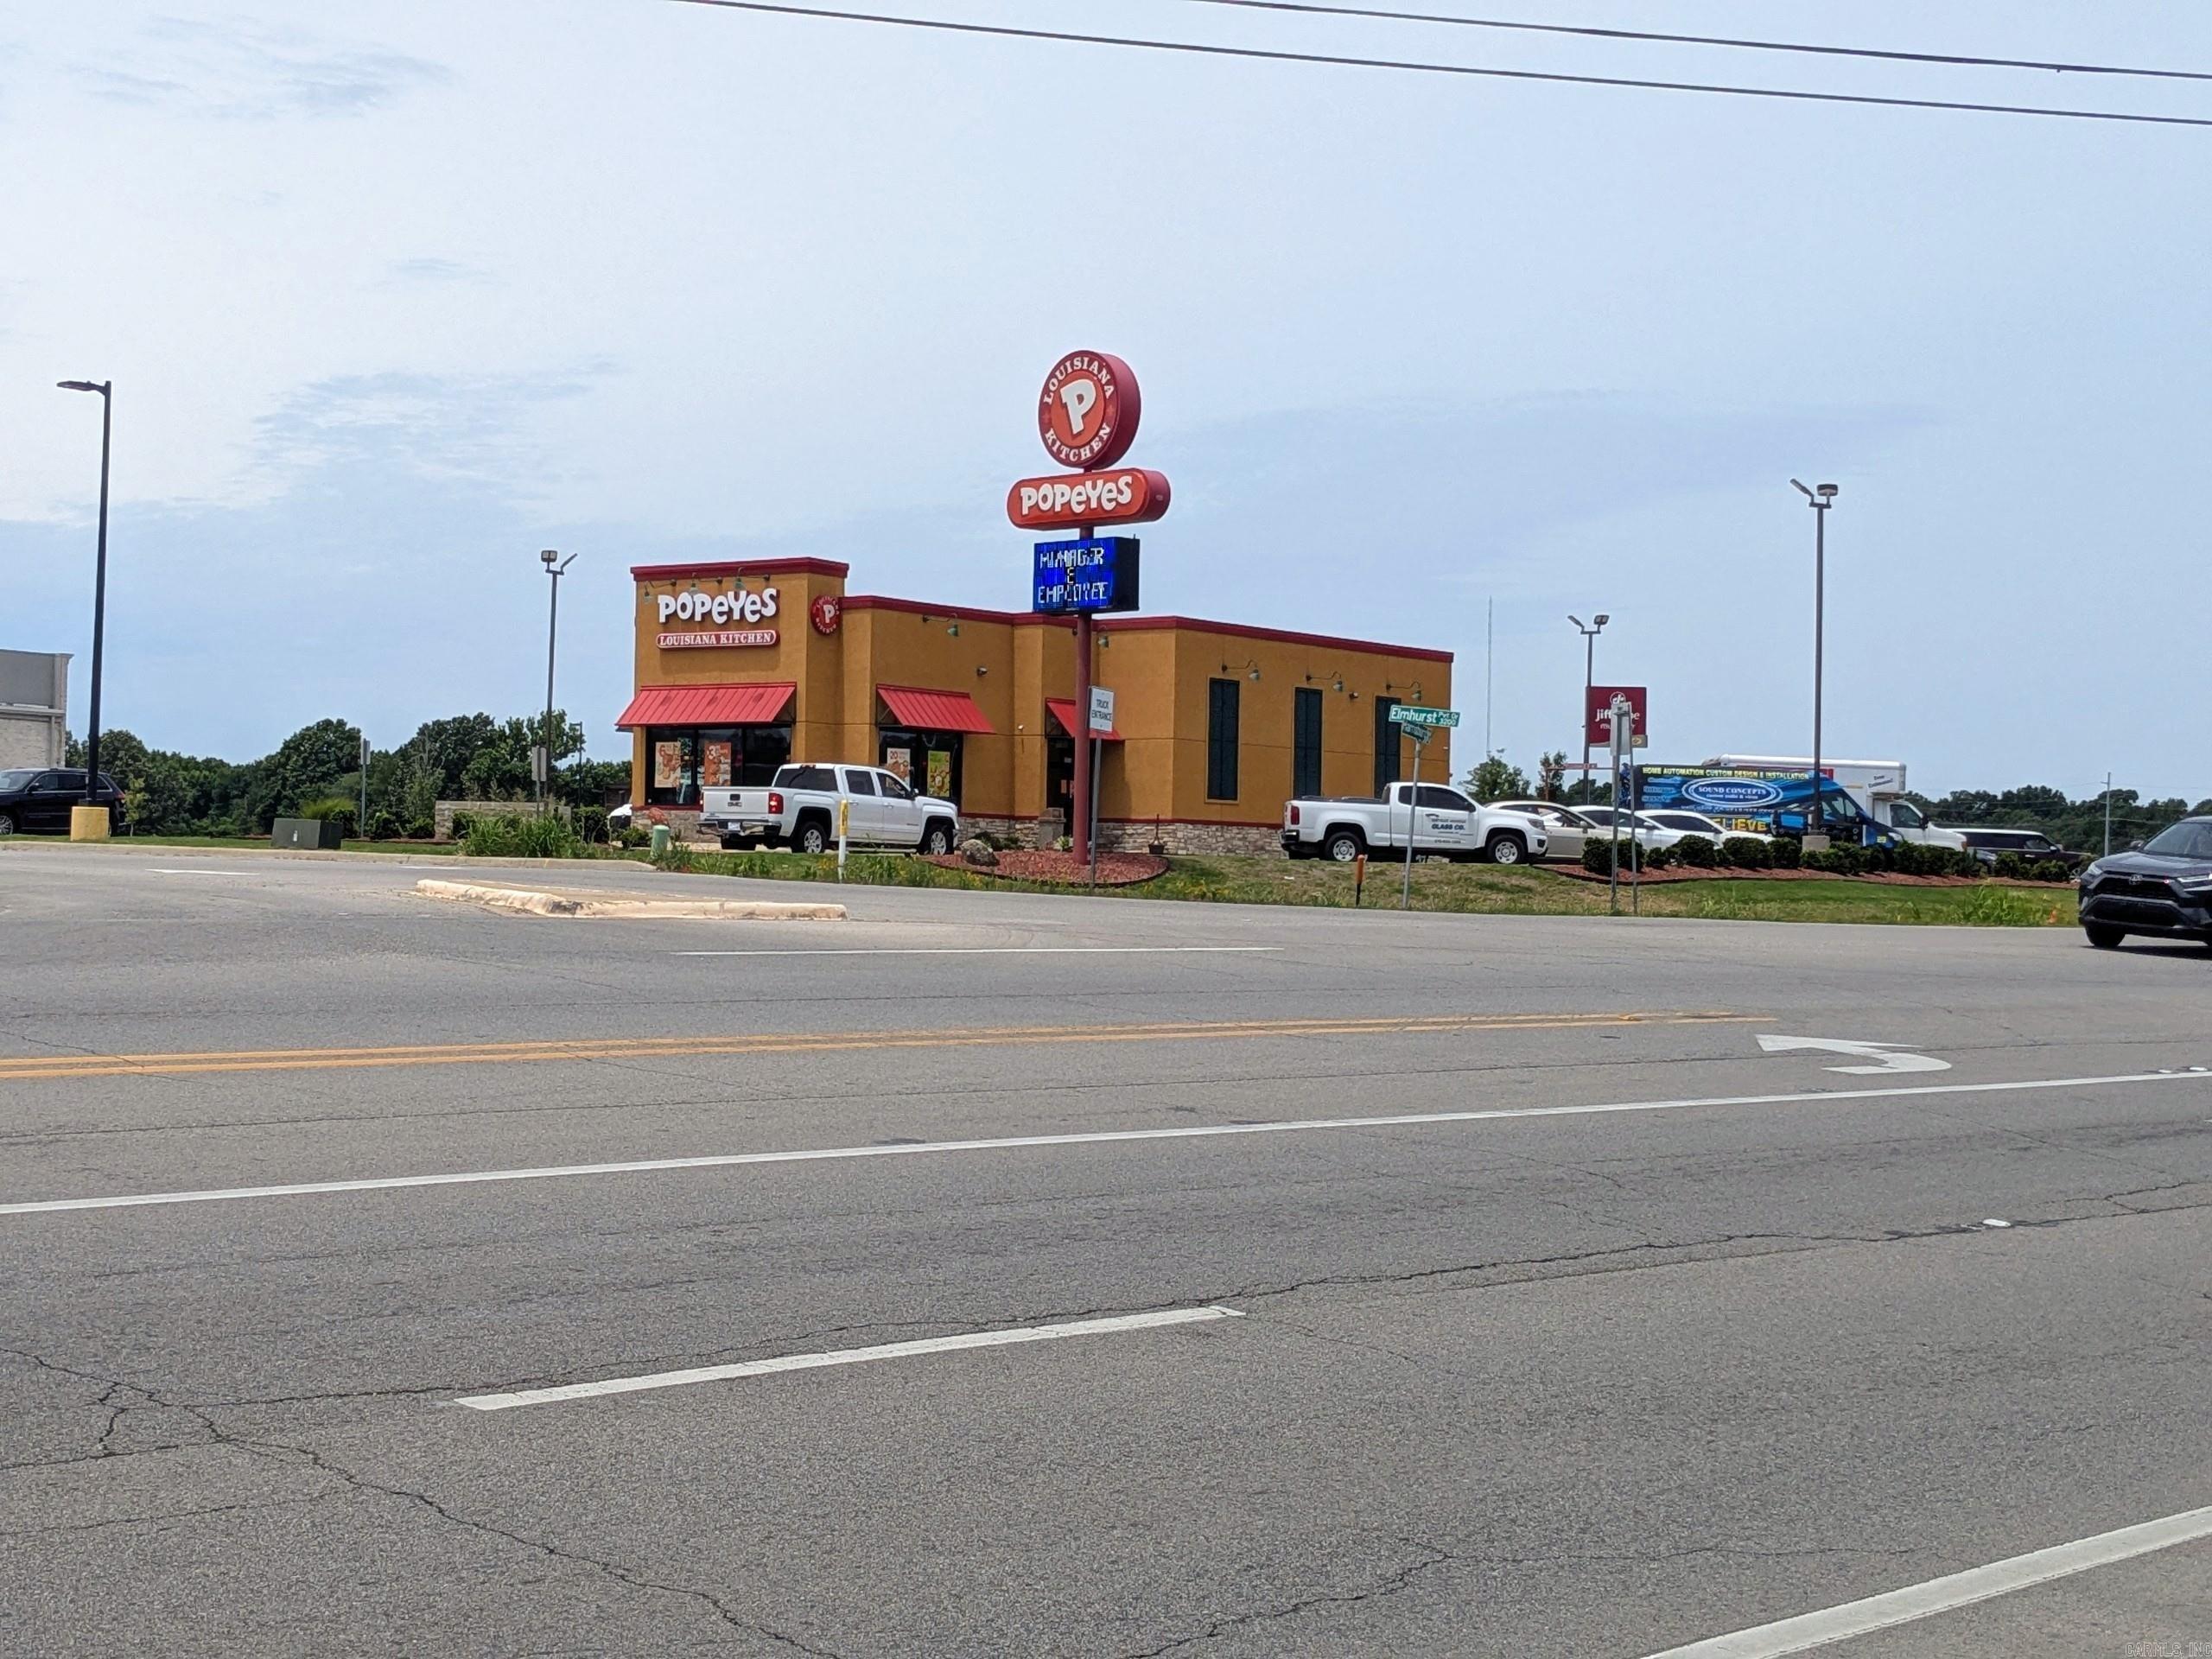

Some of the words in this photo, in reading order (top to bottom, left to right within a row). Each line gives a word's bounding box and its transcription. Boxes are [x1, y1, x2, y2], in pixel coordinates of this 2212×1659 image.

[1044, 357, 1115, 404] LOUISIANA
[1059, 378, 1096, 435] P
[1045, 423, 1111, 462] KITCHEN
[660, 633, 716, 646] LOUISIANA
[720, 632, 772, 645] KITCHEN
[1391, 708, 1438, 723] Elmhurst
[1663, 767, 1704, 776] AUTOMATION
[1765, 771, 1808, 780] INSTALLATION
